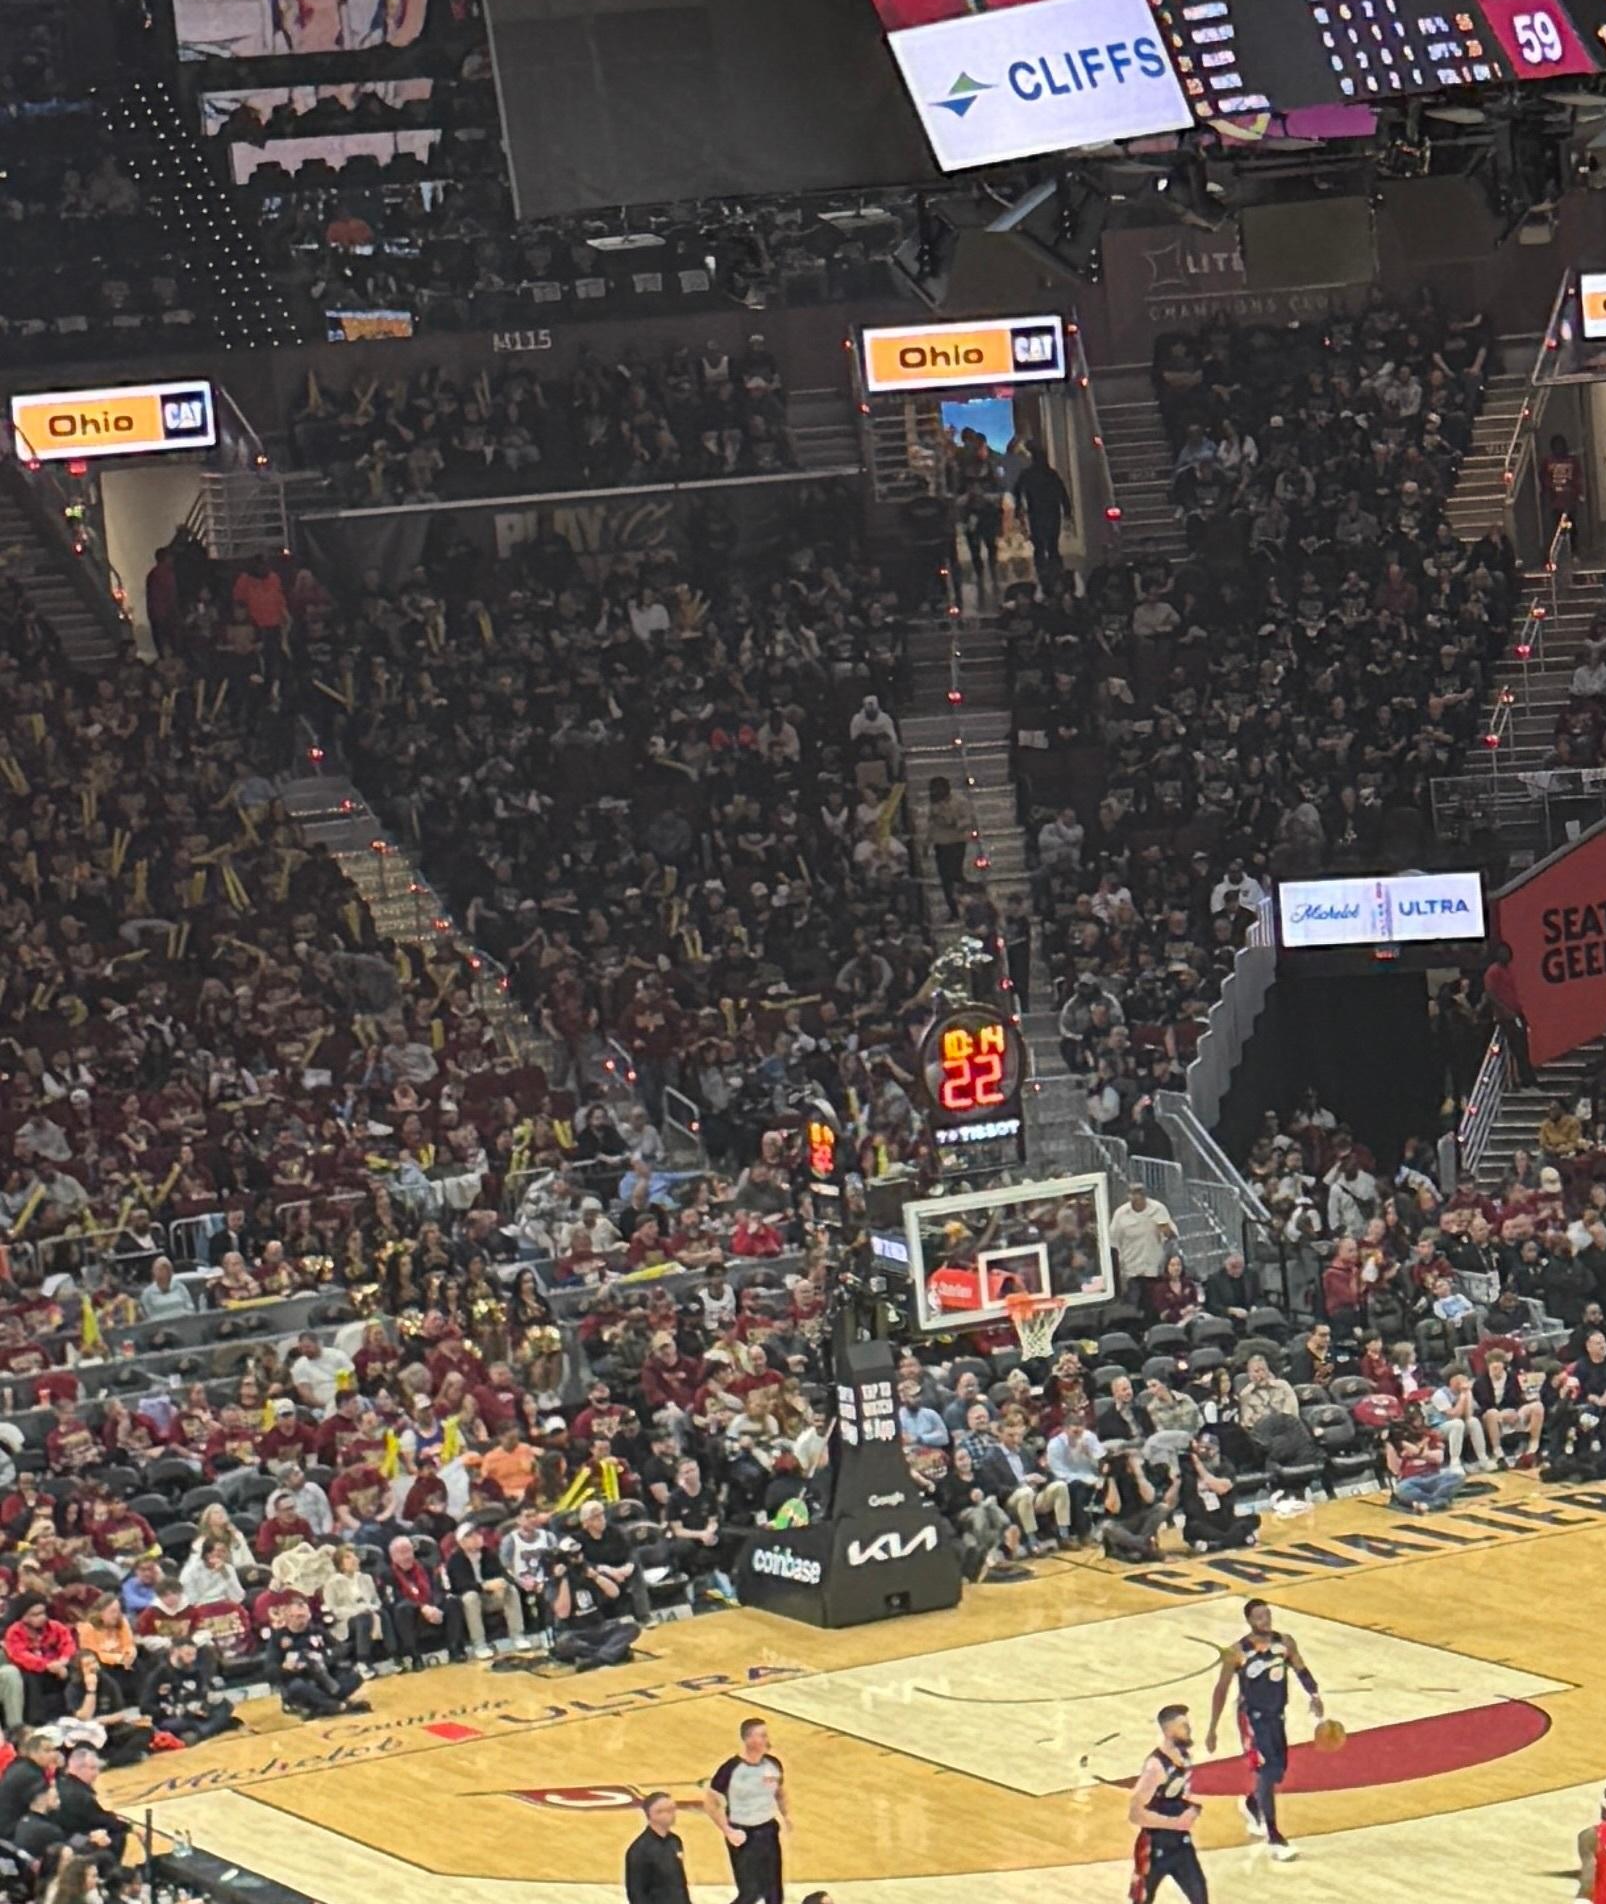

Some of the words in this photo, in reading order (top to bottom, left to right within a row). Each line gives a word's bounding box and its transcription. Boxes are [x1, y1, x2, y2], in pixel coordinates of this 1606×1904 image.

[1513, 11, 1562, 64] 59
[1007, 37, 1167, 102] CLIFFS
[1186, 252, 1243, 274] LITE
[899, 345, 984, 370] Ohio
[48, 411, 134, 438] Ohio
[163, 400, 204, 428] CAT
[1399, 898, 1470, 917] ULTRA
[943, 1054, 1004, 1109] 22
[753, 1546, 821, 1584] coinbase
[499, 1663, 806, 1724] ULTRA
